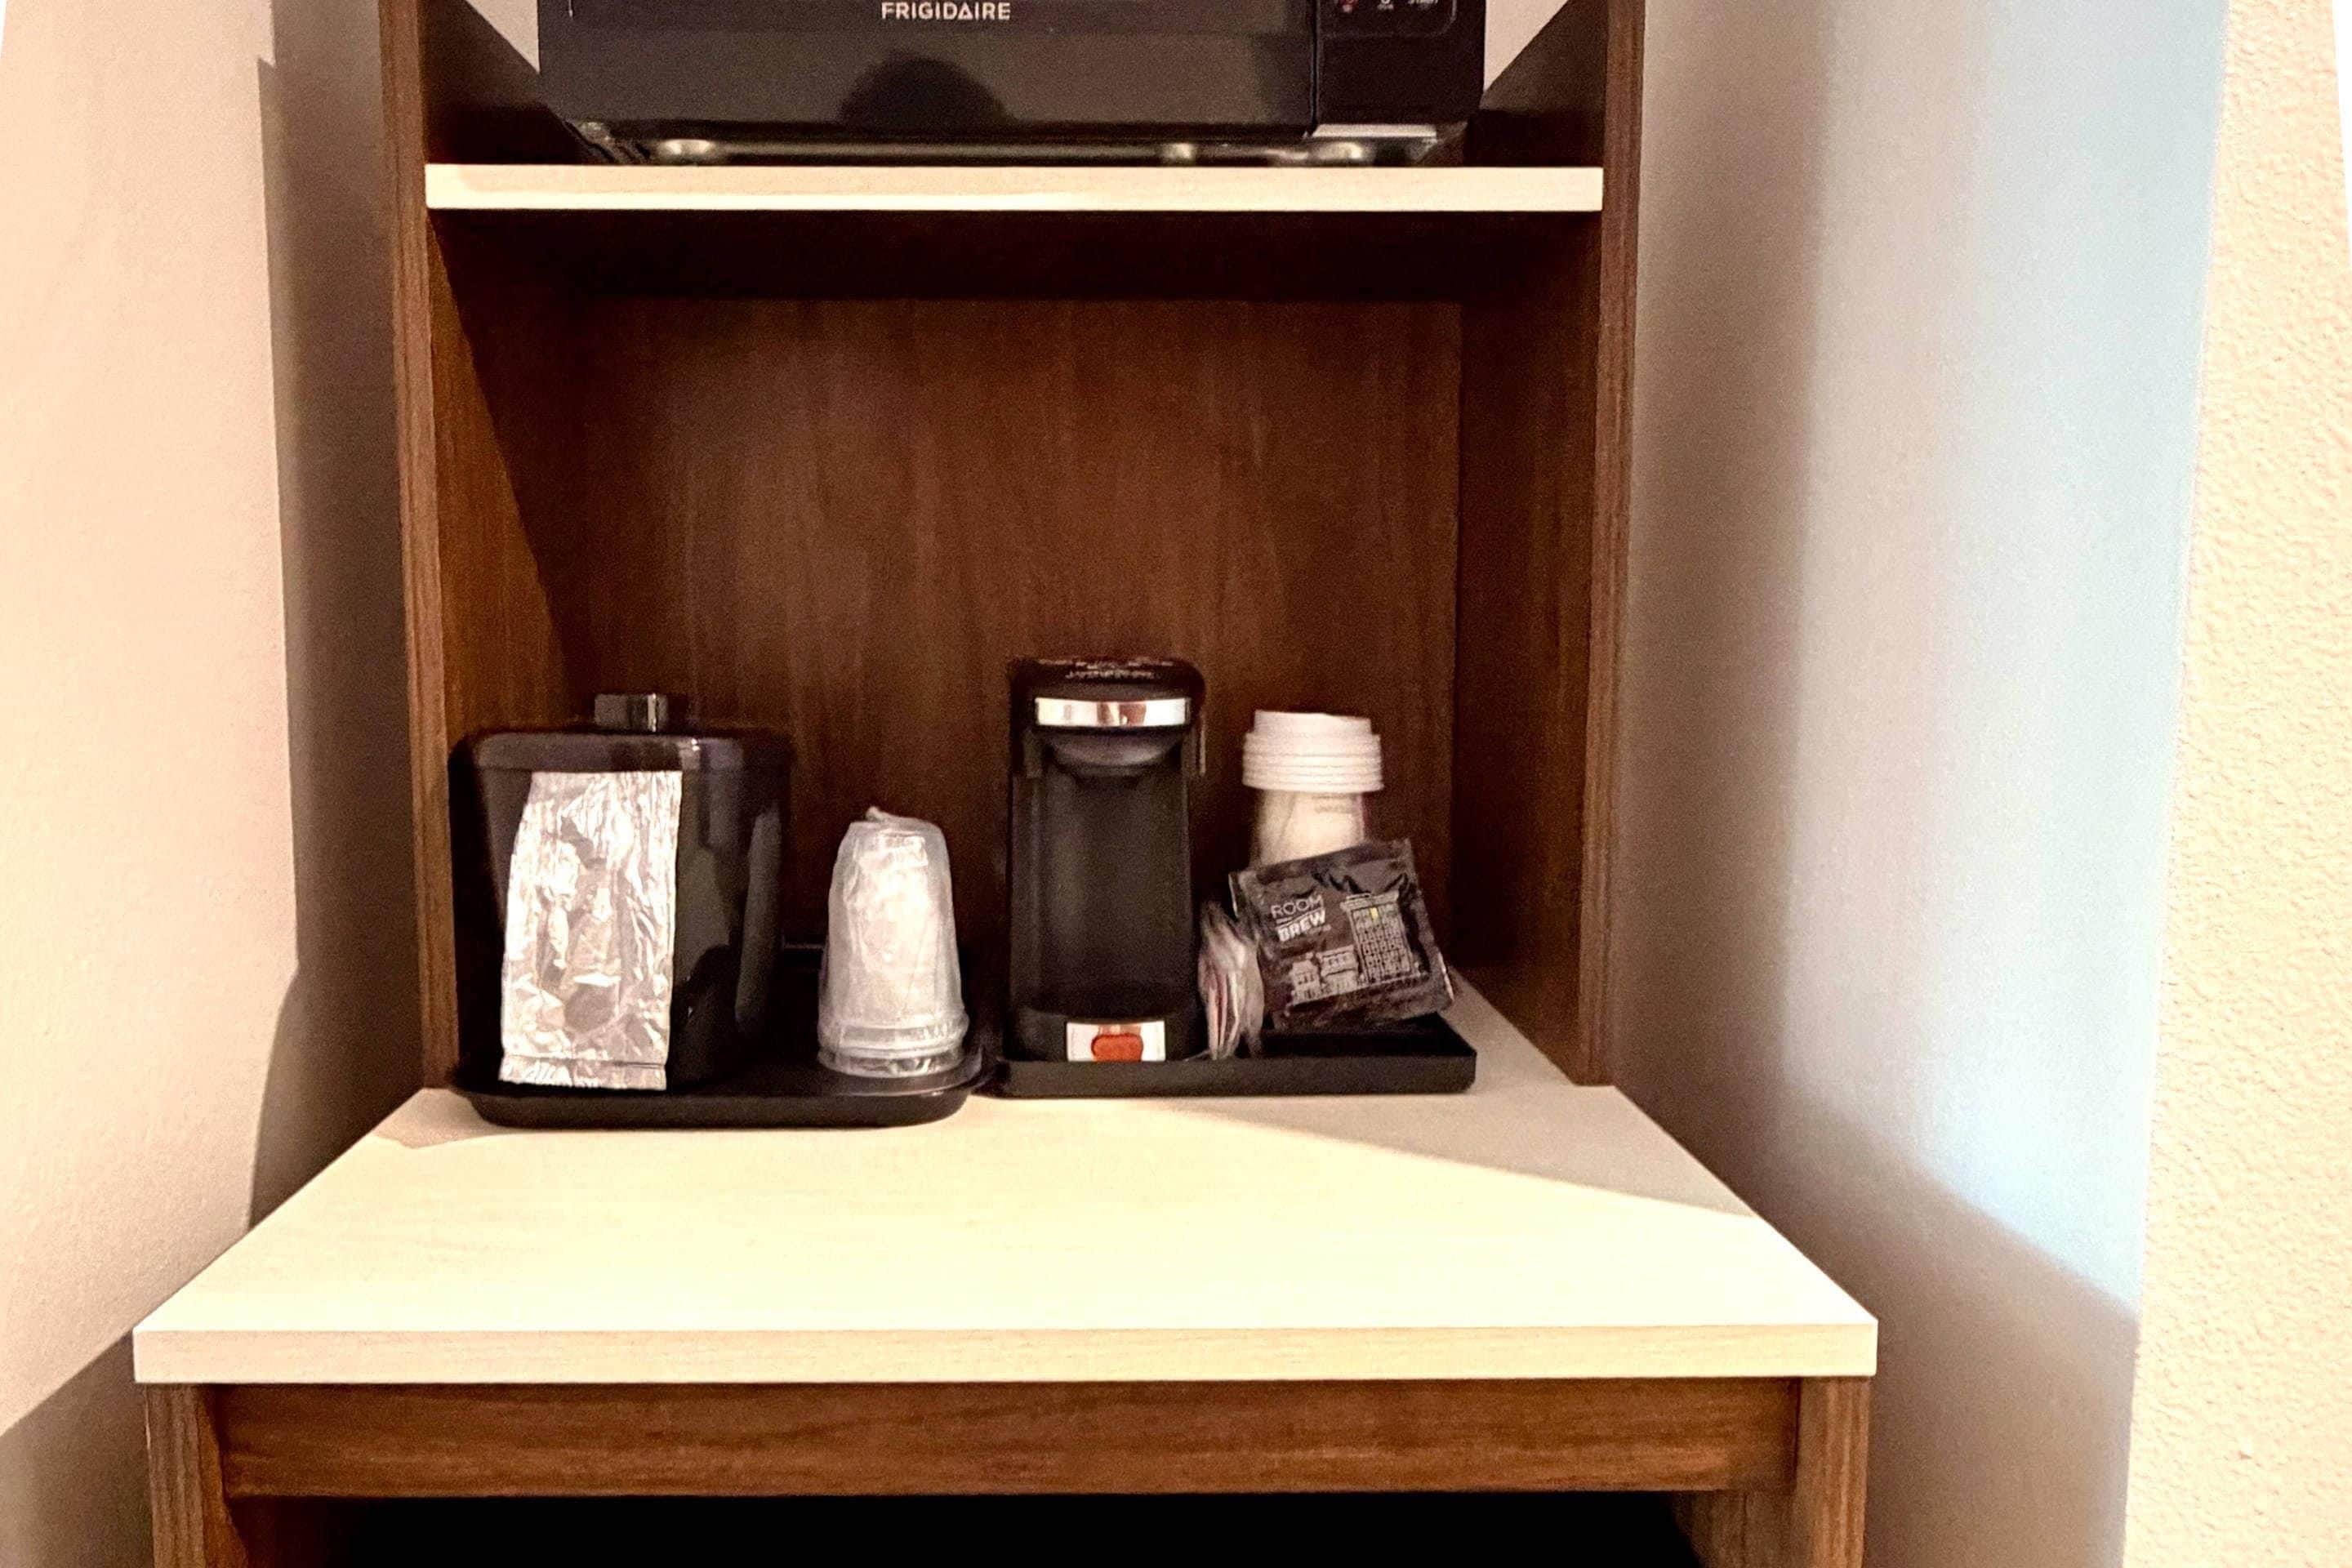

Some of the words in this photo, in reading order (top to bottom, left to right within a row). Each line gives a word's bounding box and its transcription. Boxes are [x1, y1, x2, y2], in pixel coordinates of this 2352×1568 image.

[881, 2, 1011, 20] FRIGIDAIRE
[1271, 894, 1324, 919] ROOM
[1277, 909, 1325, 942] BREW
